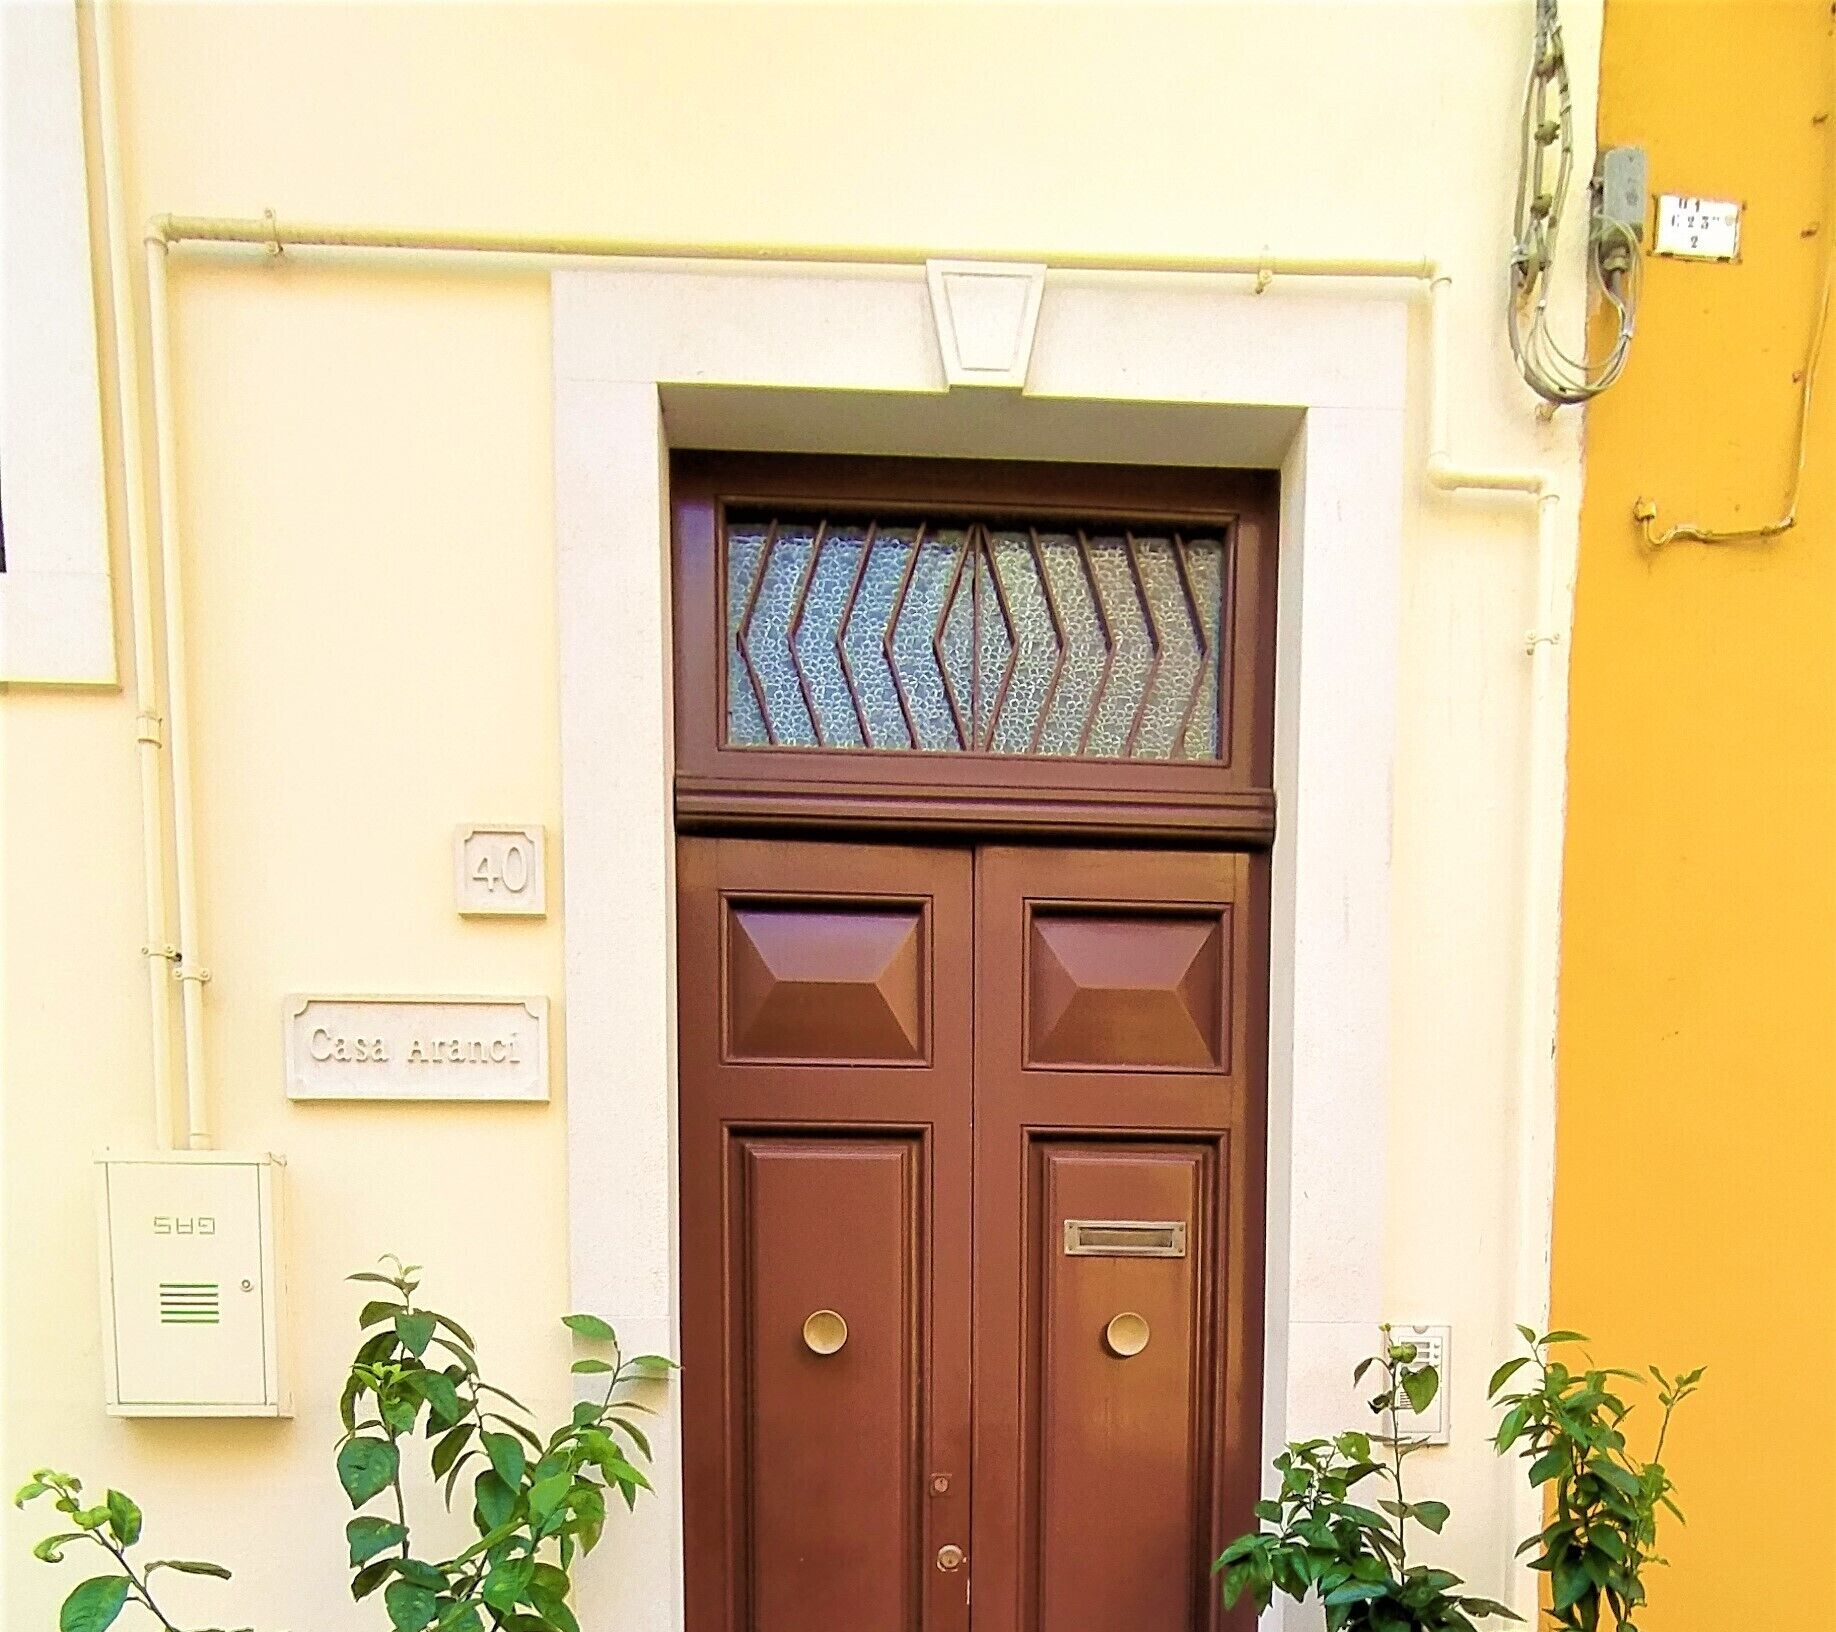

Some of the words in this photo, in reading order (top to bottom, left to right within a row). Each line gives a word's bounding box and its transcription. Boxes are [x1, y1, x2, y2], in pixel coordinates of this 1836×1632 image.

[470, 843, 528, 894] 40
[310, 1026, 390, 1064] Casa
[405, 1032, 521, 1065] Aranci
[153, 1216, 215, 1235] GAS
